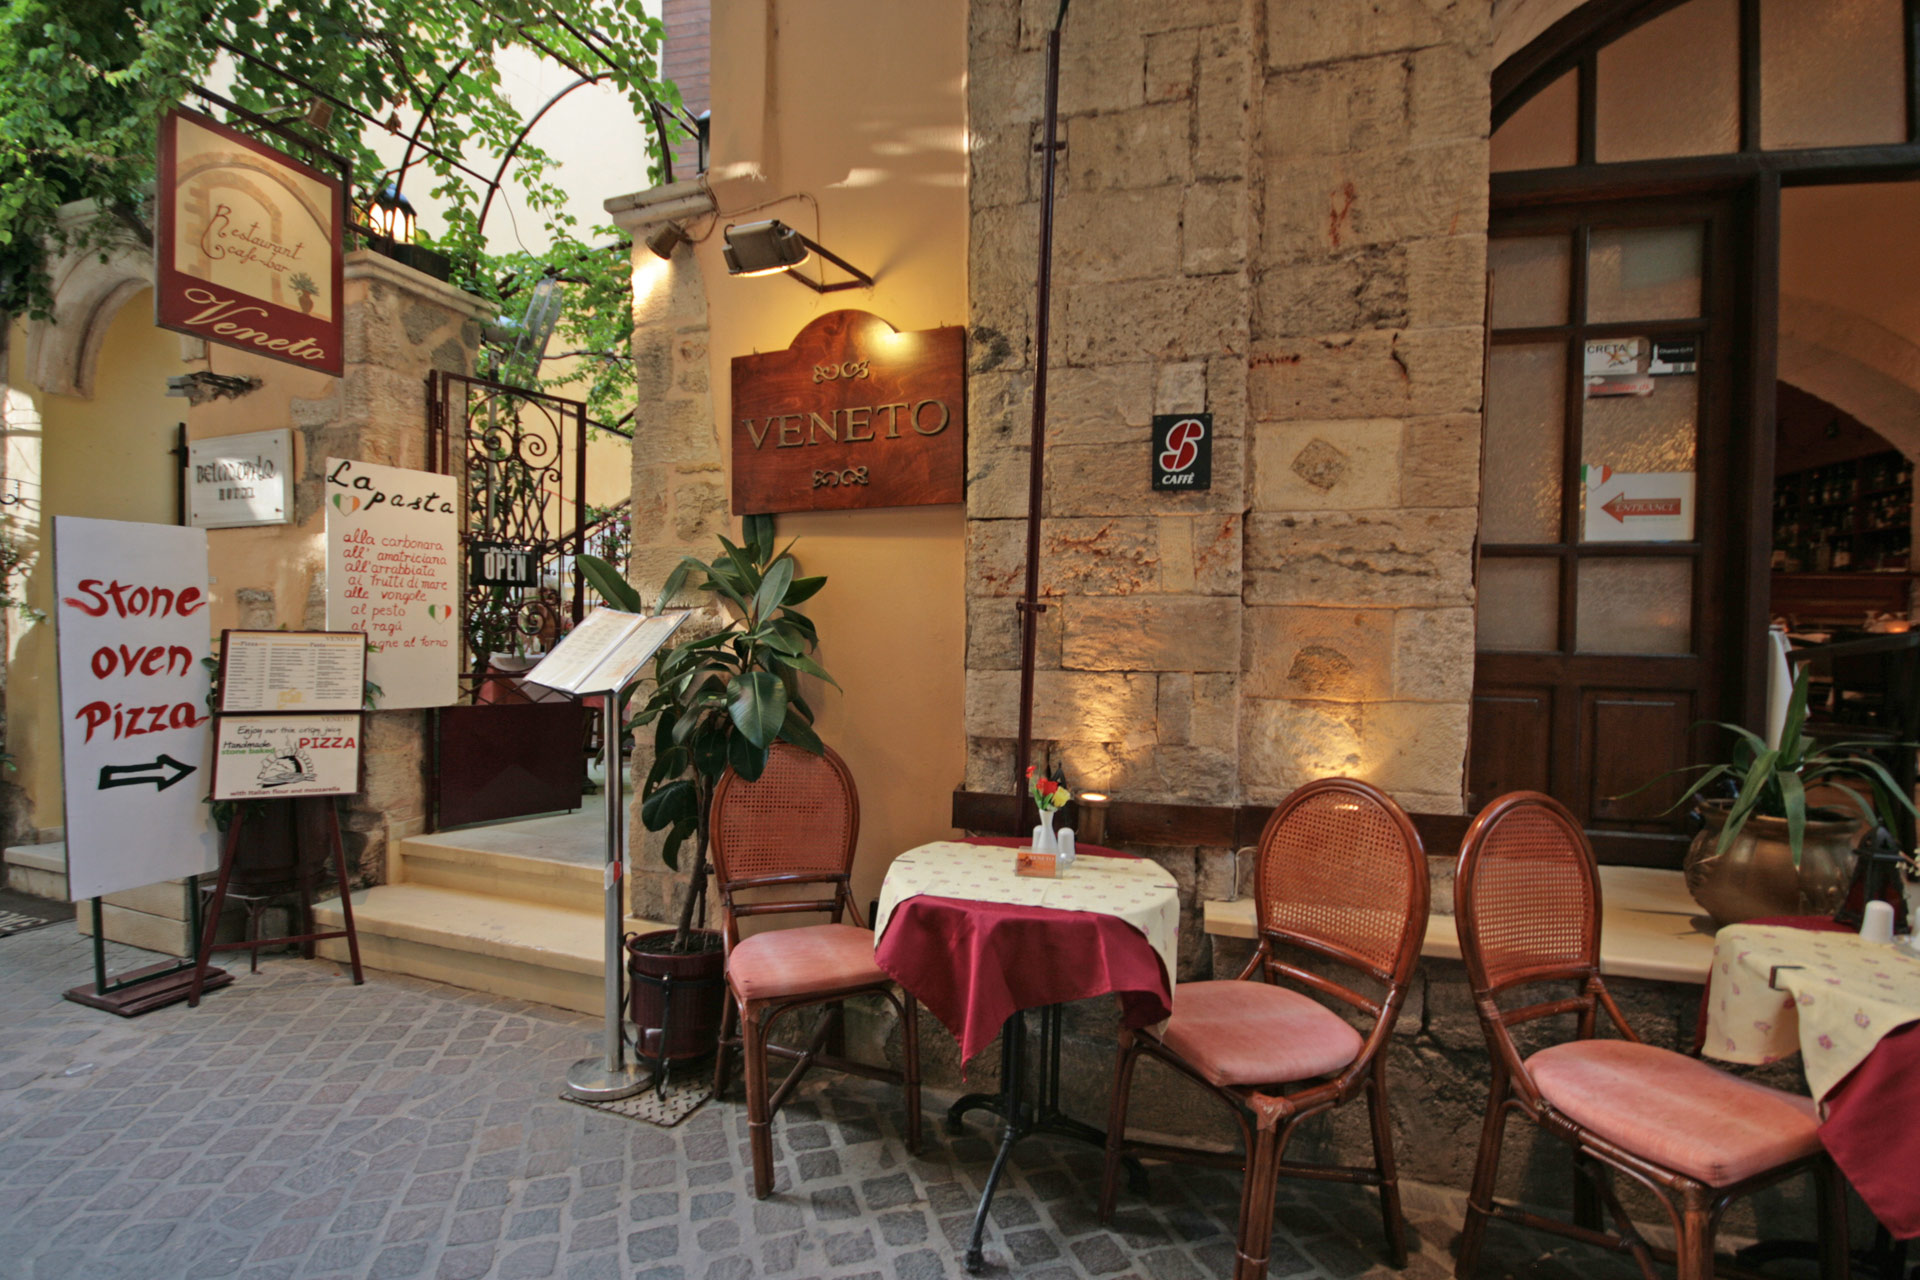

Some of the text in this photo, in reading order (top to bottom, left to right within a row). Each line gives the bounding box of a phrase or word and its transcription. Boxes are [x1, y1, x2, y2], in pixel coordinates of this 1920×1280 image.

[201, 203, 305, 260] Restaurant
[184, 288, 325, 360] Veneto
[1587, 344, 1627, 354] CRETA
[742, 399, 950, 450] VENETO
[1161, 472, 1195, 485] CAFFÈ
[327, 461, 455, 514] La pasta
[1615, 504, 1675, 512] ENTRANCE
[343, 527, 444, 551] alla carbonara
[377, 550, 447, 565] amatriciana
[484, 552, 526, 582] OPEN
[406, 576, 419, 588] di
[421, 580, 448, 591] mare
[64, 579, 207, 619] Stone
[343, 586, 427, 605] alle vongole
[350, 603, 406, 620] al pesto
[351, 619, 366, 632] al
[403, 636, 416, 648] al
[91, 644, 193, 680] oven
[75, 700, 211, 745] Pizza
[237, 725, 263, 740] Enjoy
[222, 737, 356, 749] Handmade PIZZA
[248, 747, 276, 755] baked
